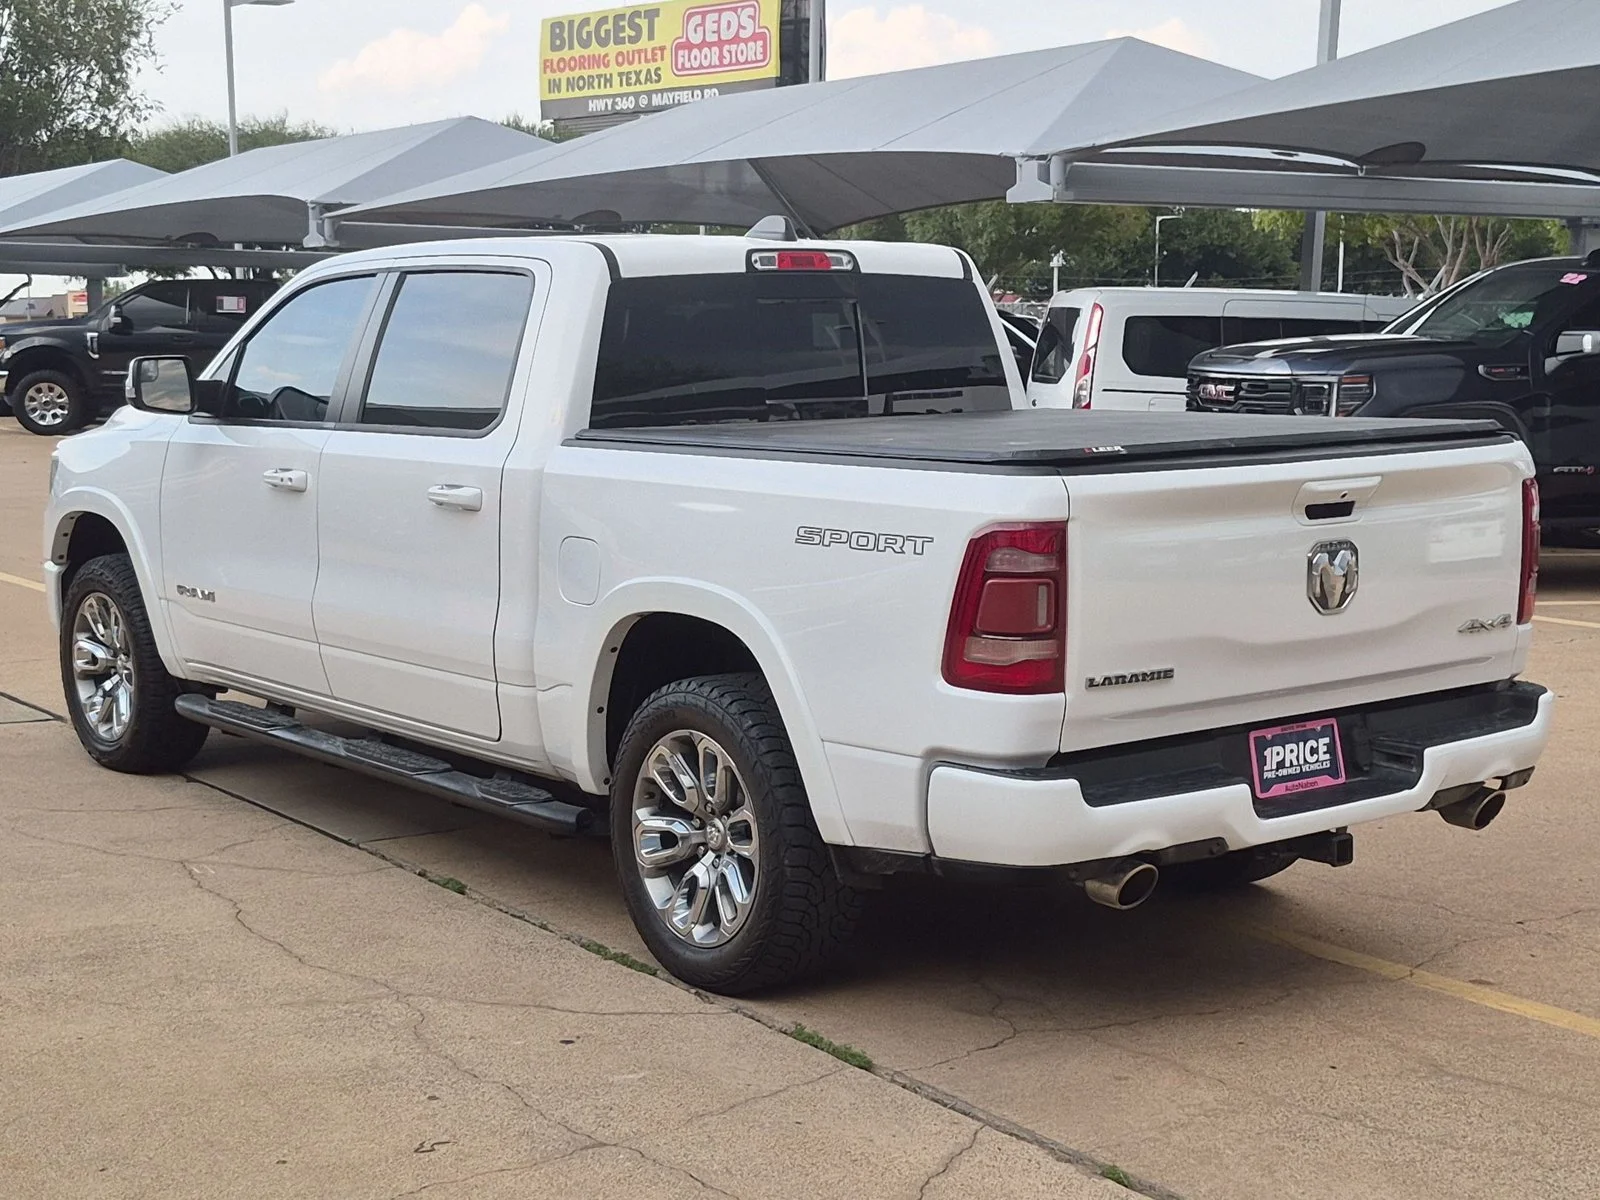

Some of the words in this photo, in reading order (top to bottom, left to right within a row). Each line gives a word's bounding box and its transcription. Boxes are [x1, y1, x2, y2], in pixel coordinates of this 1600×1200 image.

[550, 8, 660, 52] BIGGEST
[687, 7, 756, 44] GED'S
[543, 53, 610, 74] FLOORING
[615, 45, 666, 68] OUTLET
[677, 47, 720, 70] FLOOR
[723, 40, 764, 63] STORE
[548, 78, 562, 94] IN
[566, 73, 613, 92] NORTH
[620, 67, 662, 87] TEXAS
[588, 98, 613, 112] HWY
[615, 97, 635, 110] 360
[639, 96, 648, 107] @
[652, 90, 702, 106] MAYFIELD
[1199, 384, 1235, 401] GMC
[795, 526, 934, 555] SPORT
[176, 584, 216, 602] RAM
[1085, 667, 1174, 689] LARAMIE
[1263, 737, 1331, 771] 1PRICE
[1263, 766, 1300, 779] PRE-OWNED
[1301, 761, 1331, 772] VEHICLES
[1285, 780, 1318, 792] AutoNation
